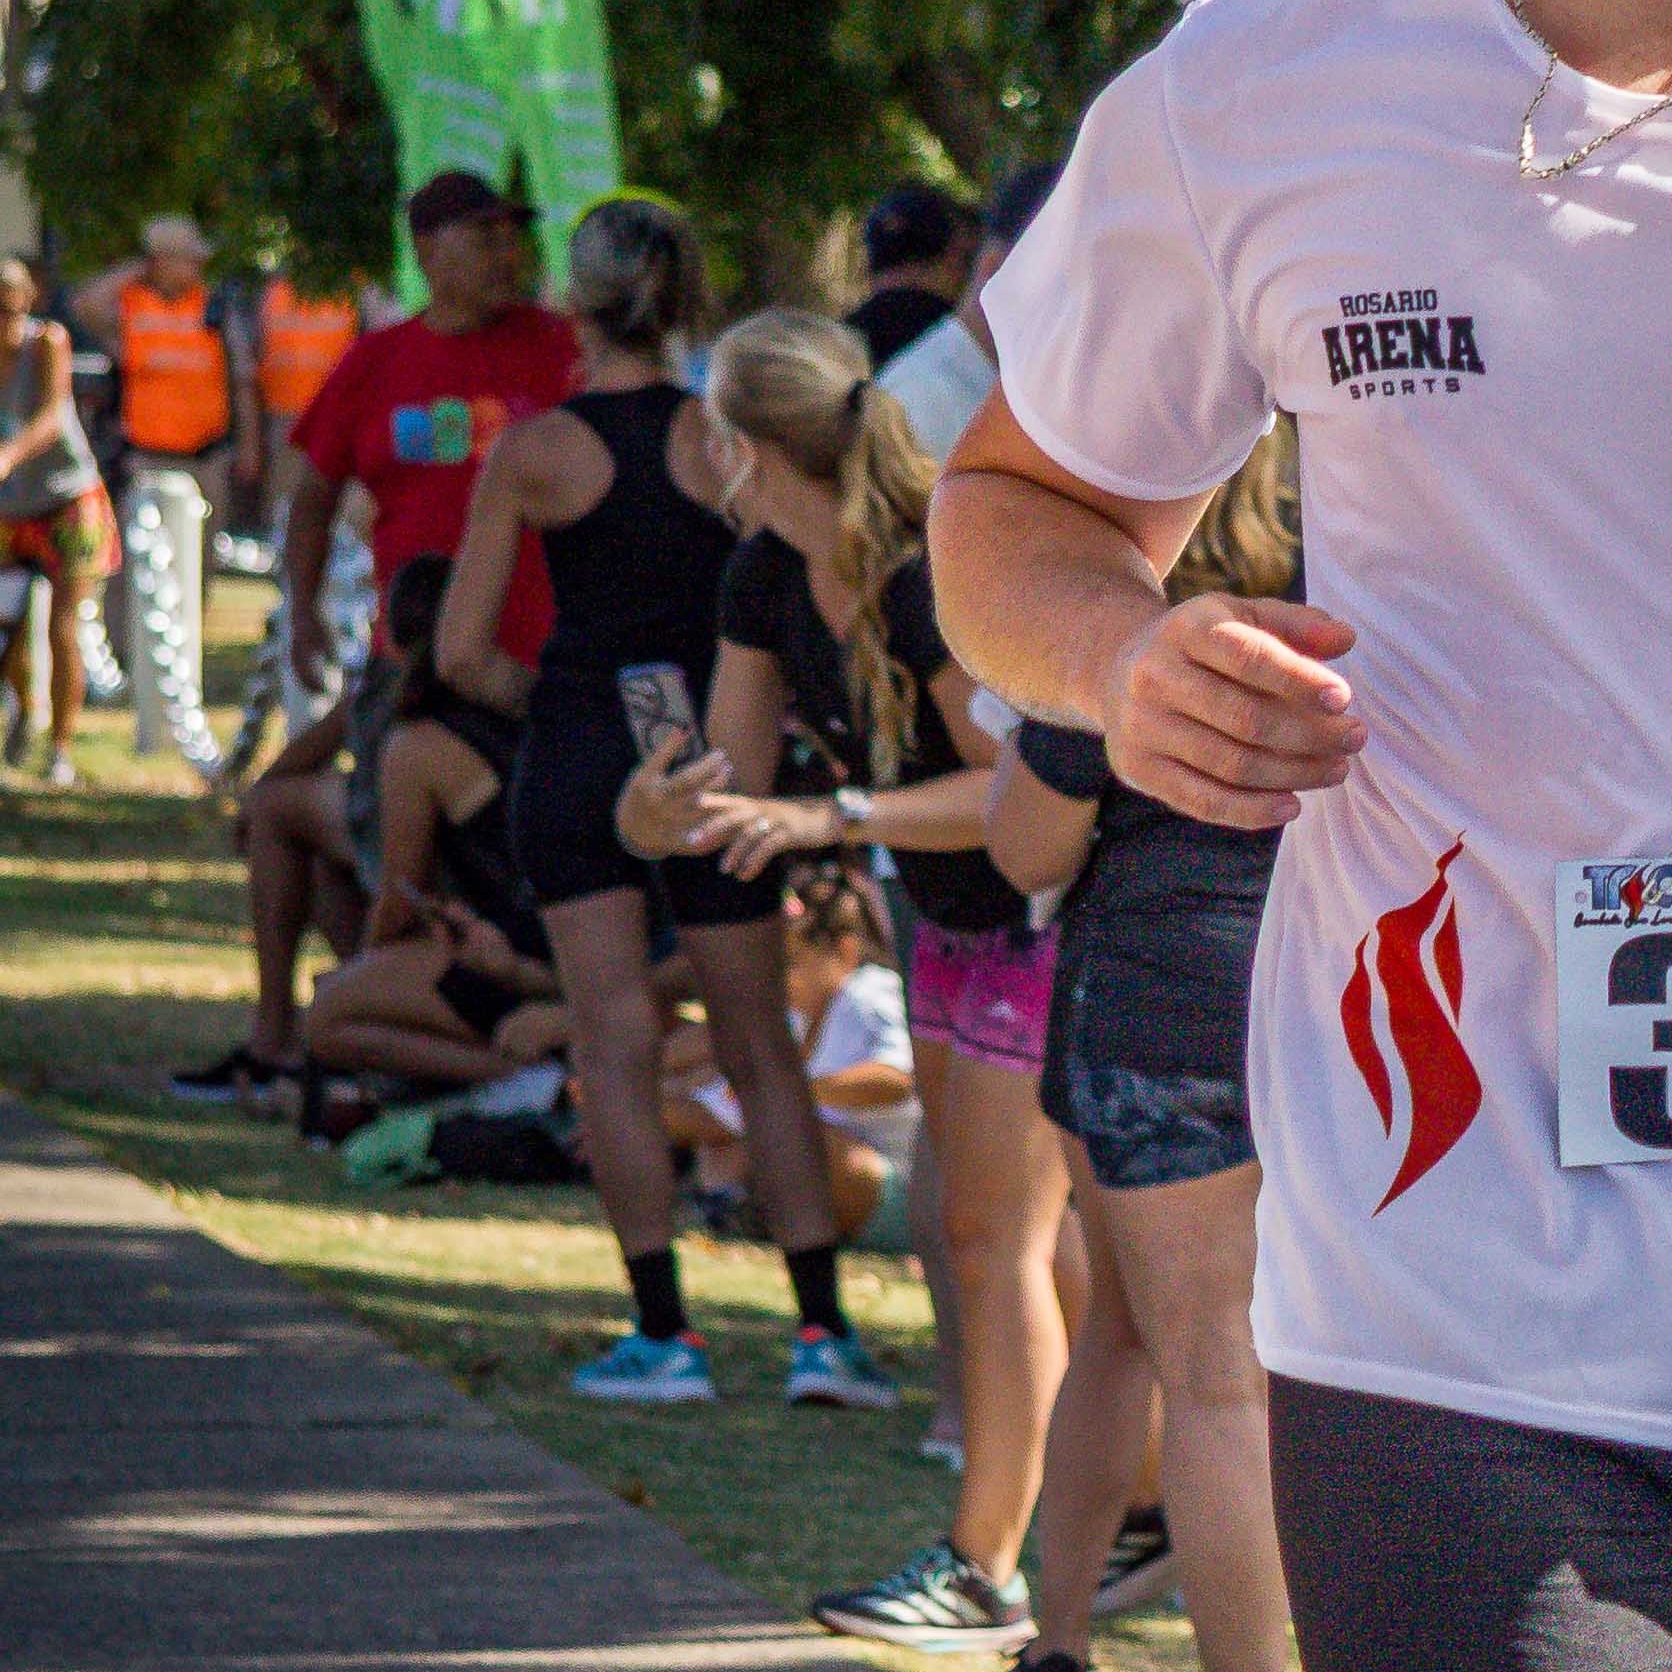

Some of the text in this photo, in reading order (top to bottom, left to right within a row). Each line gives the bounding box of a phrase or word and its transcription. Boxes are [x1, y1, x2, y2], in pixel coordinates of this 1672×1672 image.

[1340, 289, 1439, 317] ROSARIO
[1321, 316, 1486, 386] ARENA
[1350, 378, 1461, 400] SPORTS
